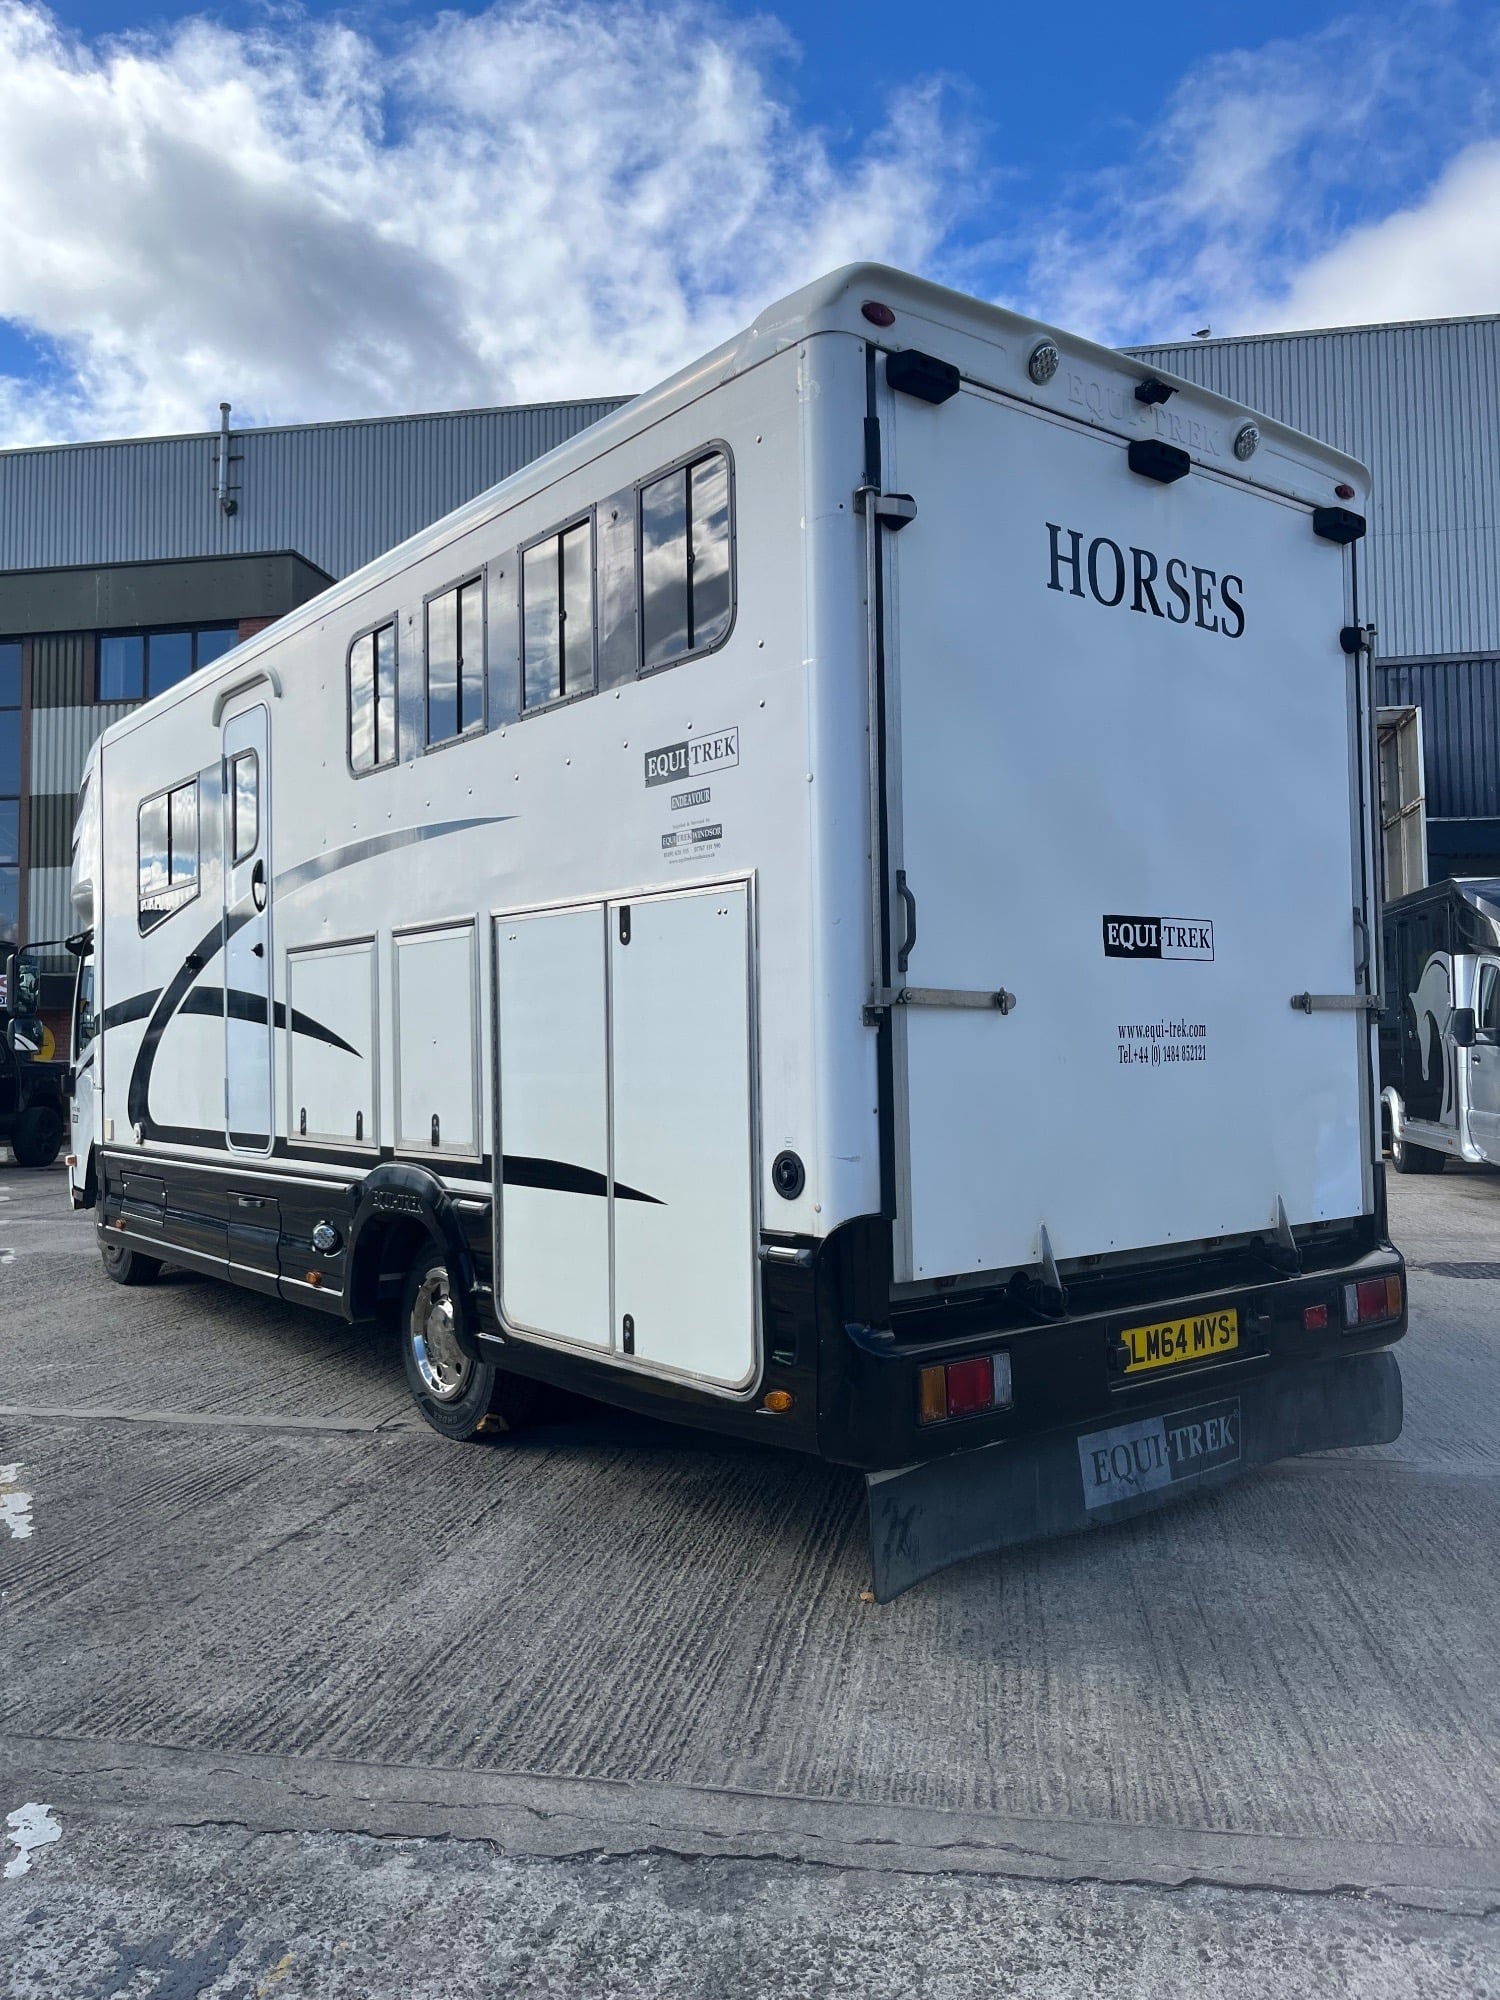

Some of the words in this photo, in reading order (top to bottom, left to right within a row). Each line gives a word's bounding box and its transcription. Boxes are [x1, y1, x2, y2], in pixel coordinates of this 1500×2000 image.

[1045, 521, 1245, 639] HORSES
[671, 790, 710, 809] ENDEAVOUR
[1117, 1018, 1207, 1043] www.equi-trek.com
[1151, 1044, 1161, 1067] (0)
[1163, 1045, 1180, 1063] 1484
[1181, 1044, 1206, 1062] 852121
[1131, 1323, 1188, 1364] LM64
[1193, 1314, 1230, 1351] MYS
